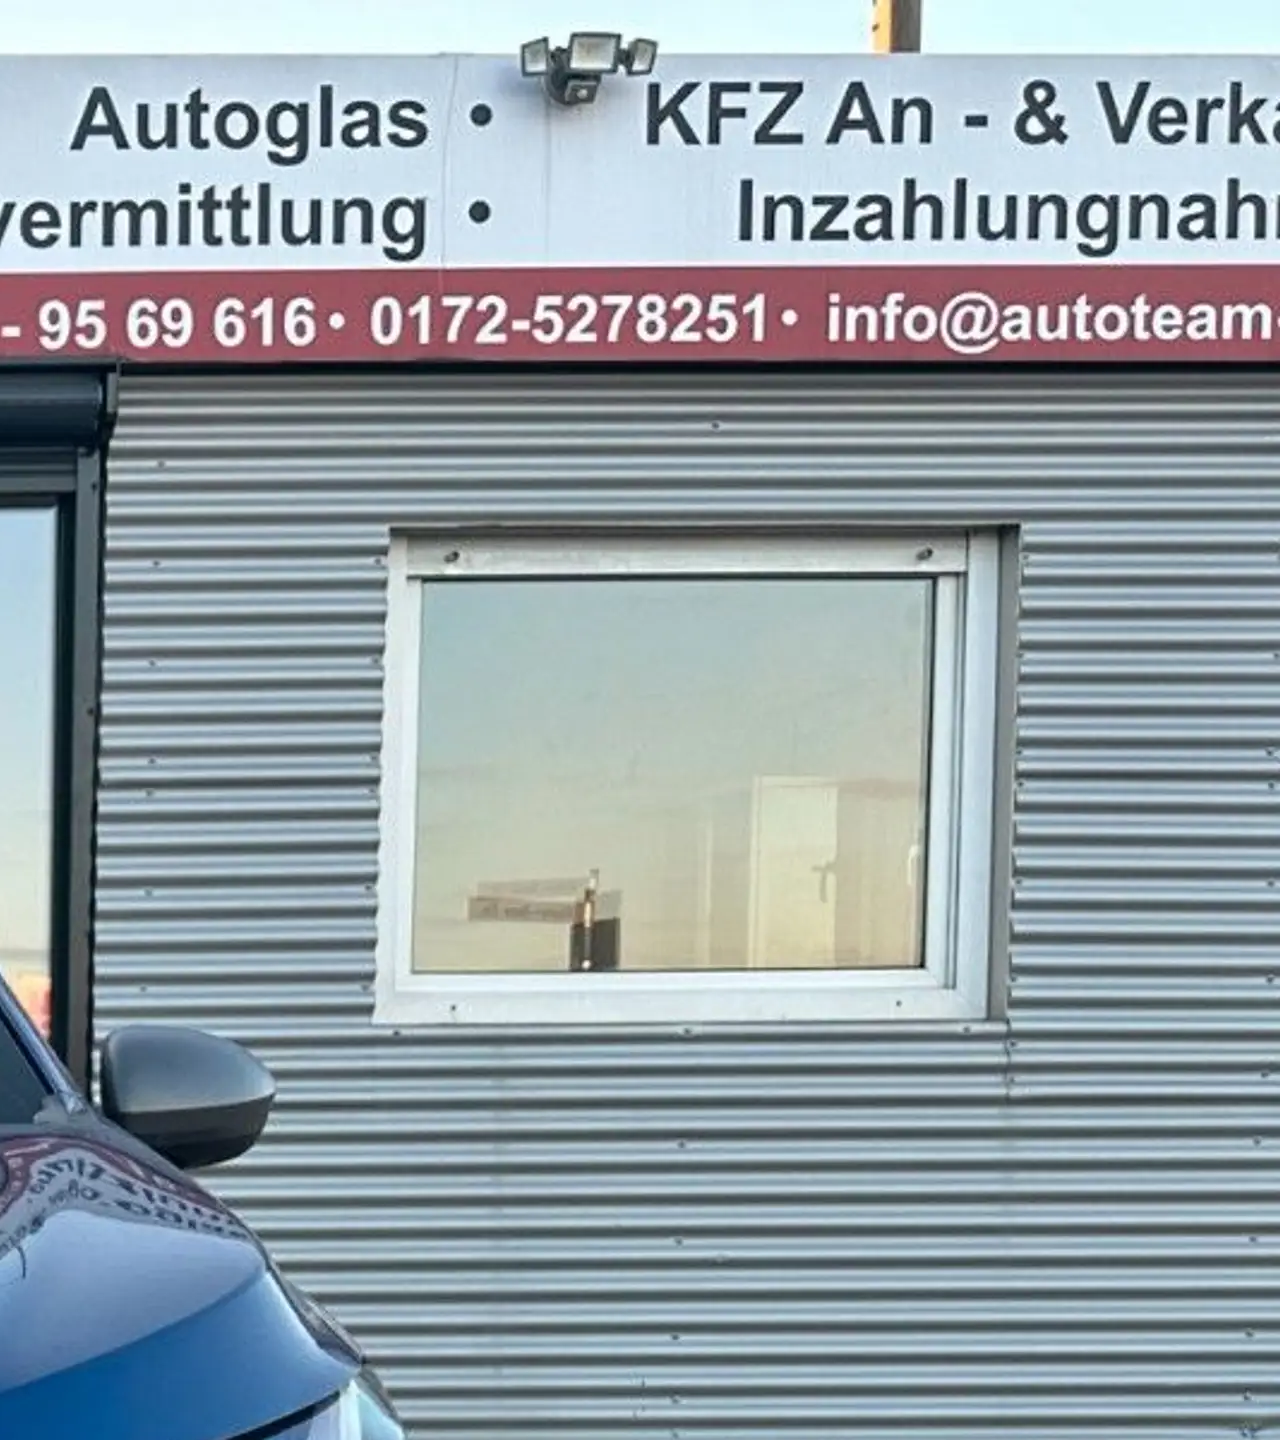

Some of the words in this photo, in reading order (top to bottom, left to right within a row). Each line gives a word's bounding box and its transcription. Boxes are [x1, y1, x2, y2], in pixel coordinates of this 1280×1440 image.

[70, 85, 429, 166] Autoglas
[646, 81, 805, 145] KFZ
[825, 81, 933, 145] An
[1014, 79, 1069, 145] &
[1095, 81, 1280, 145] Verk
[739, 178, 1280, 257] Inzahlungnah
[39, 300, 107, 350] 95
[126, 299, 194, 348] 69
[214, 298, 316, 347] 616
[370, 294, 765, 346] 0172-5278251
[828, 292, 1280, 354] info@autoteam
